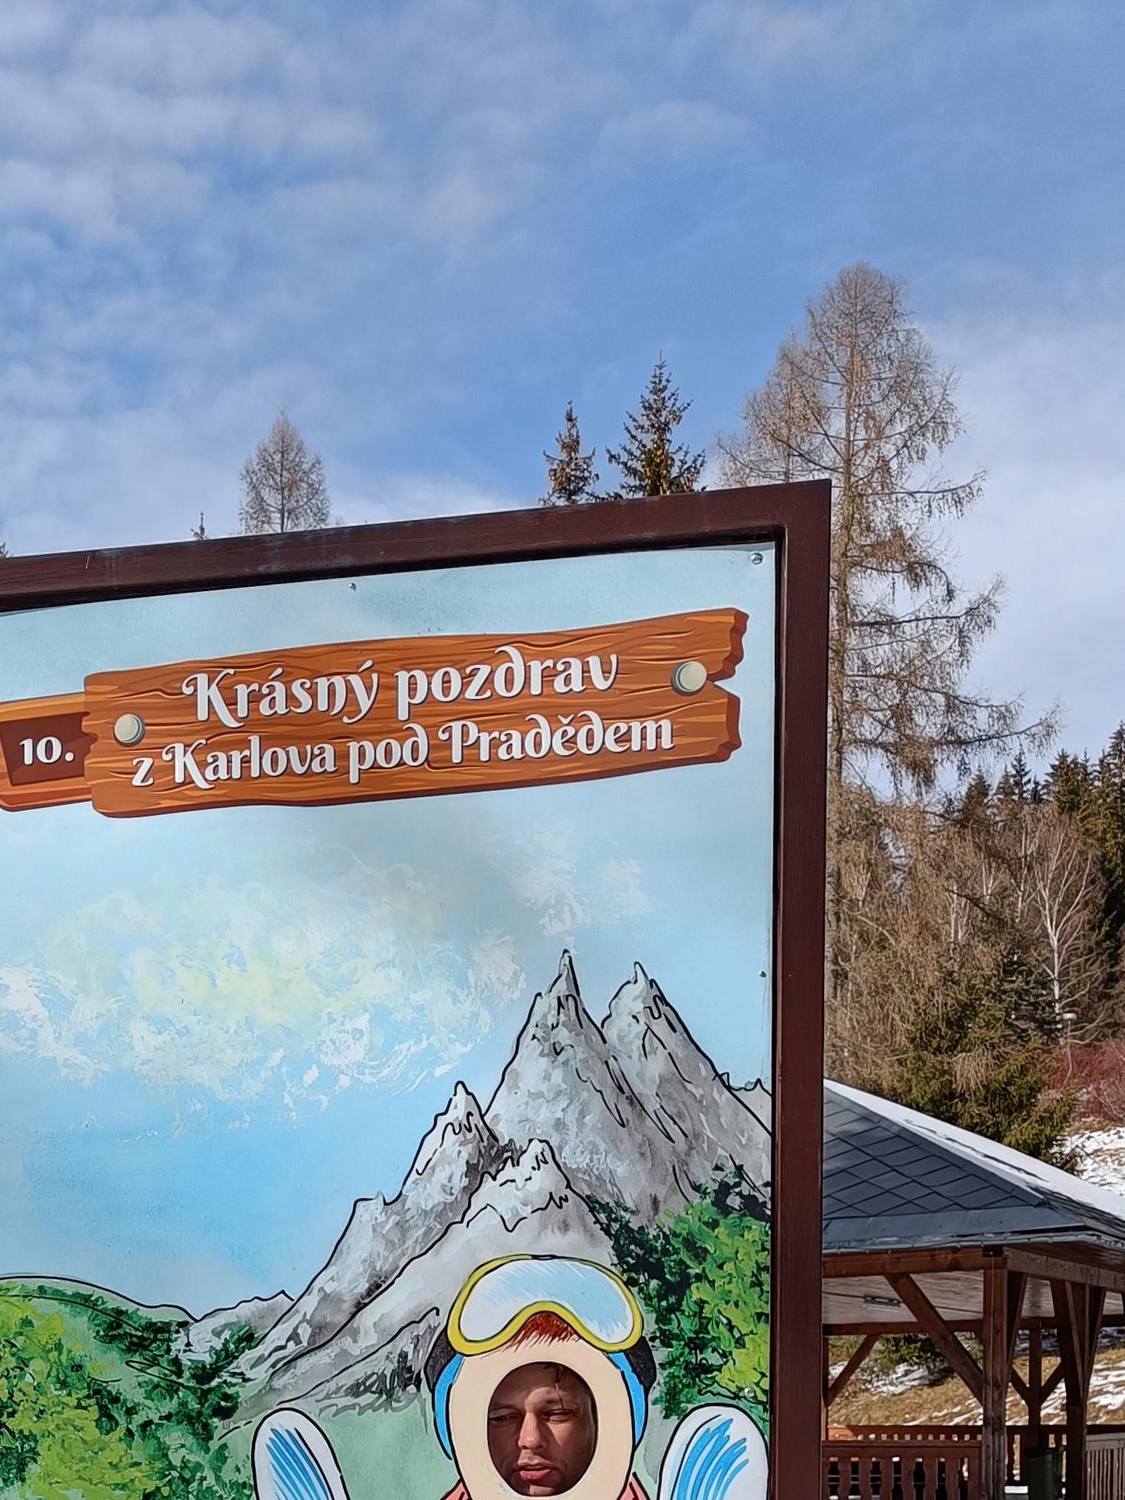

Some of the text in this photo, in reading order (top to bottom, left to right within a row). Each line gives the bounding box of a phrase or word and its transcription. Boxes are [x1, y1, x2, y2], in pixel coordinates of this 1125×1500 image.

[181, 645, 619, 729] Krásný pozdrav
[19, 736, 74, 766] 10.
[130, 710, 675, 790] z Karlova pod Pradědem
